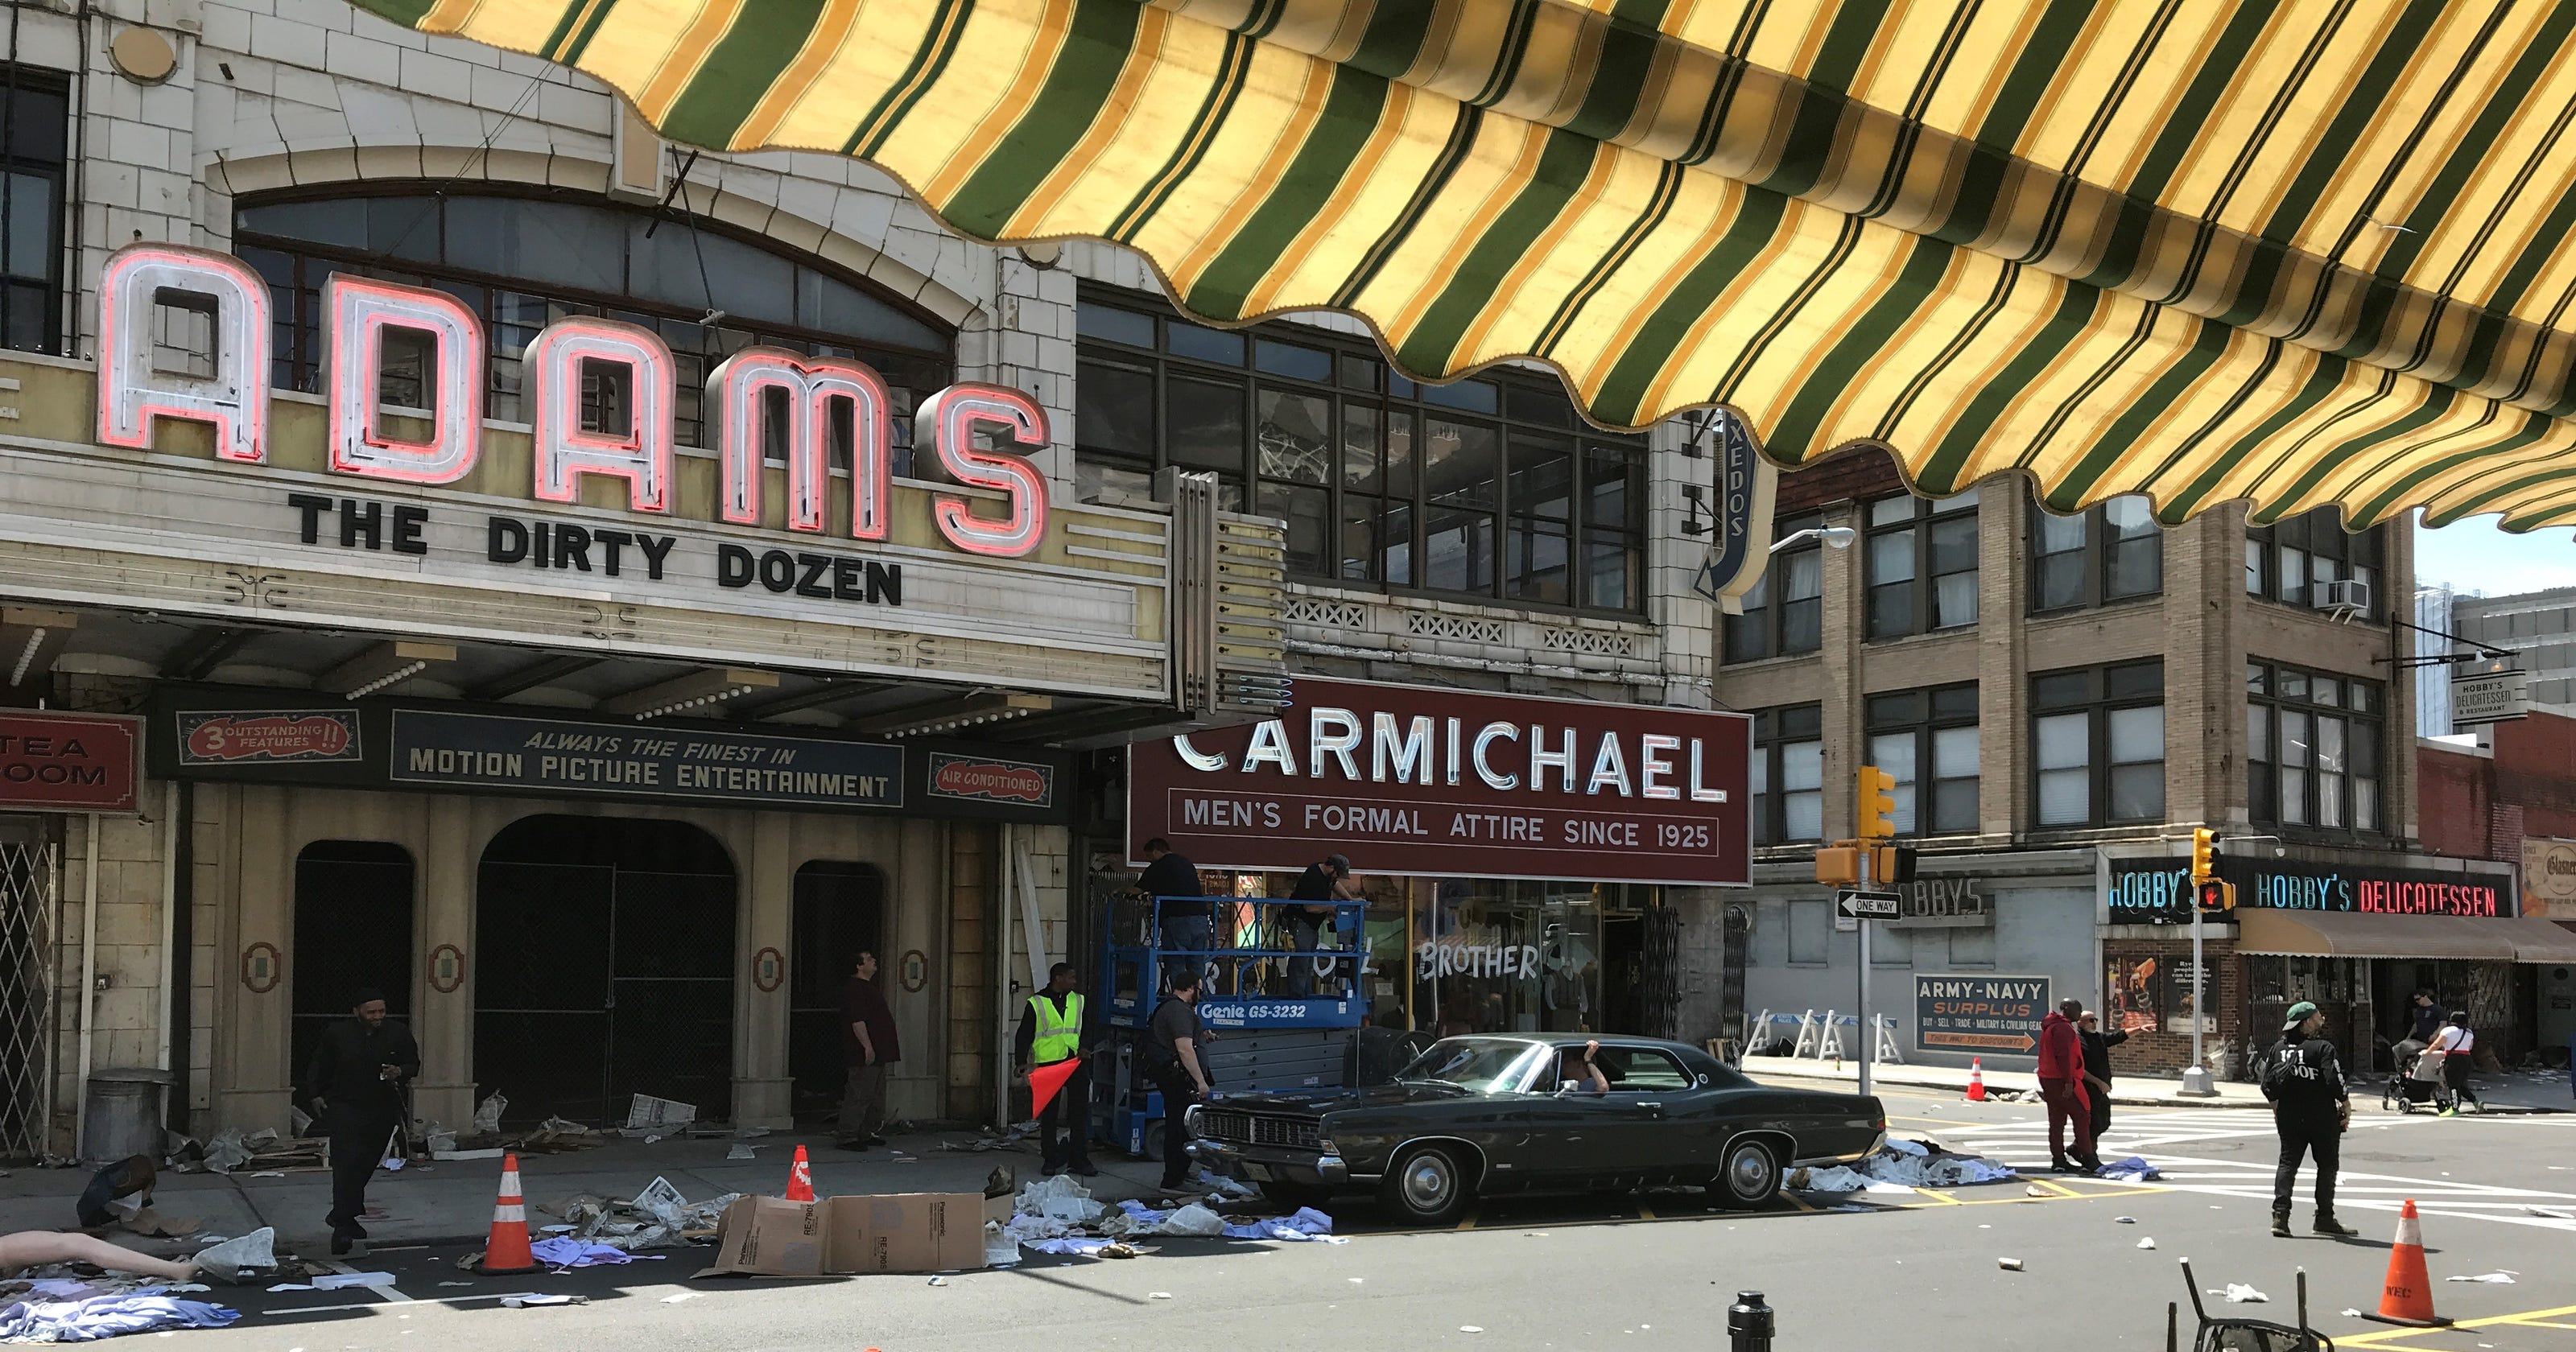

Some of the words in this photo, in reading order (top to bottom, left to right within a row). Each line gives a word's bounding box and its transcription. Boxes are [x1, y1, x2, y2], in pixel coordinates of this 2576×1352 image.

[95, 242, 1051, 557] ADAMS
[1729, 415, 1744, 537] XEDOS
[288, 493, 428, 555] THE
[488, 516, 676, 579] DIRTY
[718, 543, 902, 606] DOZEN
[2456, 690, 2511, 707] DELICATESSEN
[2463, 682, 2503, 693] HOBBY'S
[2467, 705, 2505, 715] RESTAURANT
[0, 735, 90, 760] TEA
[204, 726, 226, 750] 3
[225, 725, 322, 738] OUTSTANDING
[240, 736, 311, 749] FEATURES
[523, 732, 622, 753] ALWAYS
[630, 738, 678, 757] THE
[683, 742, 766, 763] FINEST
[769, 748, 797, 765] IN
[1174, 707, 1728, 803] CARMICHAEL
[0, 762, 108, 786] OOM
[410, 748, 522, 777] MOTION
[541, 755, 659, 785] PICTURE
[677, 764, 889, 798] ENTERTAINMENT
[942, 770, 961, 784] AIR
[964, 772, 1040, 792] CONDITIONED
[1184, 798, 1282, 828] MEN'S
[1305, 805, 1429, 835] FORMAL
[1450, 813, 1543, 842] ATTIRE
[1564, 819, 1639, 847] SINCE
[1657, 824, 1709, 848] 1925
[1899, 878, 1982, 917] BBYS
[2108, 868, 2195, 908] HOBBY'
[2258, 873, 2351, 912] HOBBY'S
[2359, 880, 2496, 917] DELICATESSEN
[1856, 900, 1874, 911] ONE
[1876, 901, 1895, 913] WAY
[1418, 942, 1539, 981] BROTHER
[1919, 981, 2042, 1000] ARMY-NAVY
[1201, 1004, 1245, 1019] Genie
[1249, 1004, 1307, 1019] GS-3232
[1934, 1001, 2031, 1017] SURPLUS
[1922, 1016, 1933, 1027] BUY
[1938, 1017, 1950, 1028] SELL
[1955, 1017, 1971, 1028] TRADE
[1976, 1018, 2000, 1029] MILITARY
[2000, 1020, 2006, 1030] &
[2006, 1020, 2028, 1031] CIVILIAN
[1930, 1033, 1946, 1041] THIS
[1967, 1035, 1978, 1043] TO
[1979, 1036, 2025, 1045] DISCOUNTS
